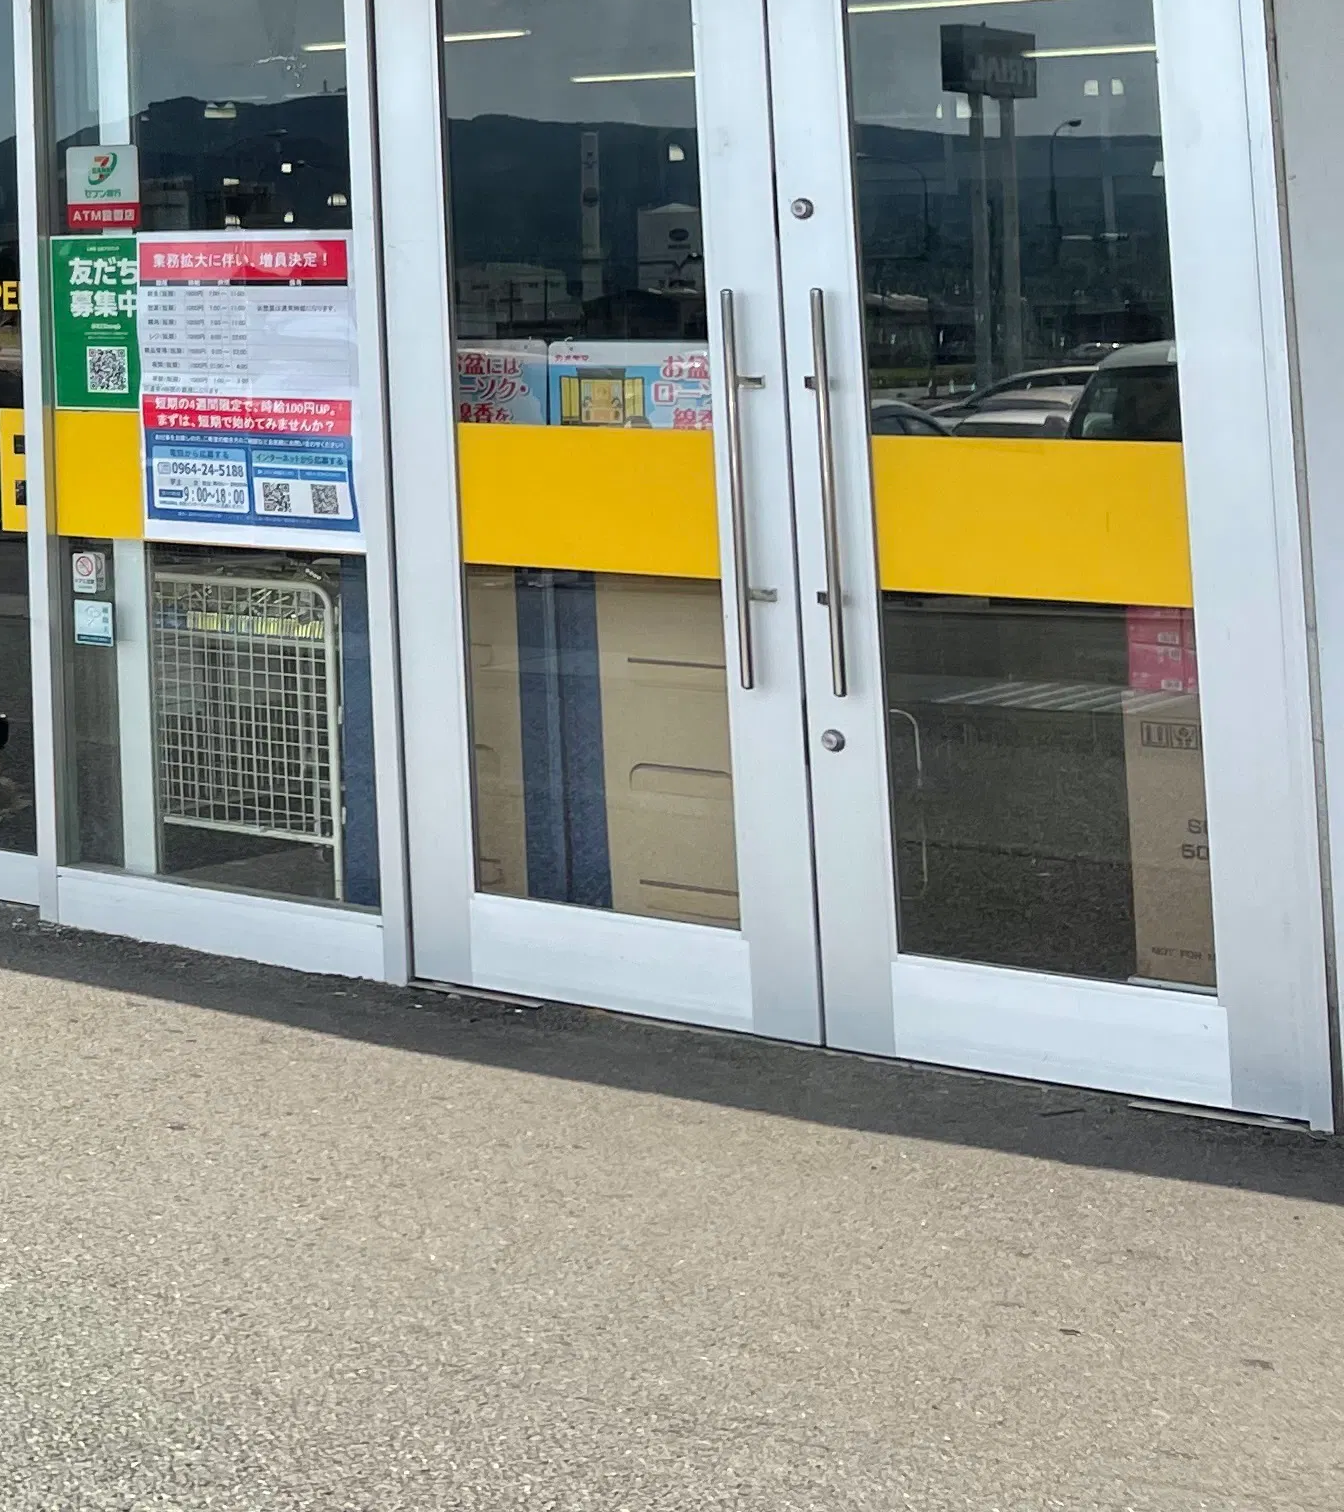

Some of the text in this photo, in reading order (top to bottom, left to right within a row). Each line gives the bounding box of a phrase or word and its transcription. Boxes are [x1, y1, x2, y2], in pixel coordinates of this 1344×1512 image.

[68, 256, 137, 285] 友だち
[70, 289, 137, 318] 募集中
